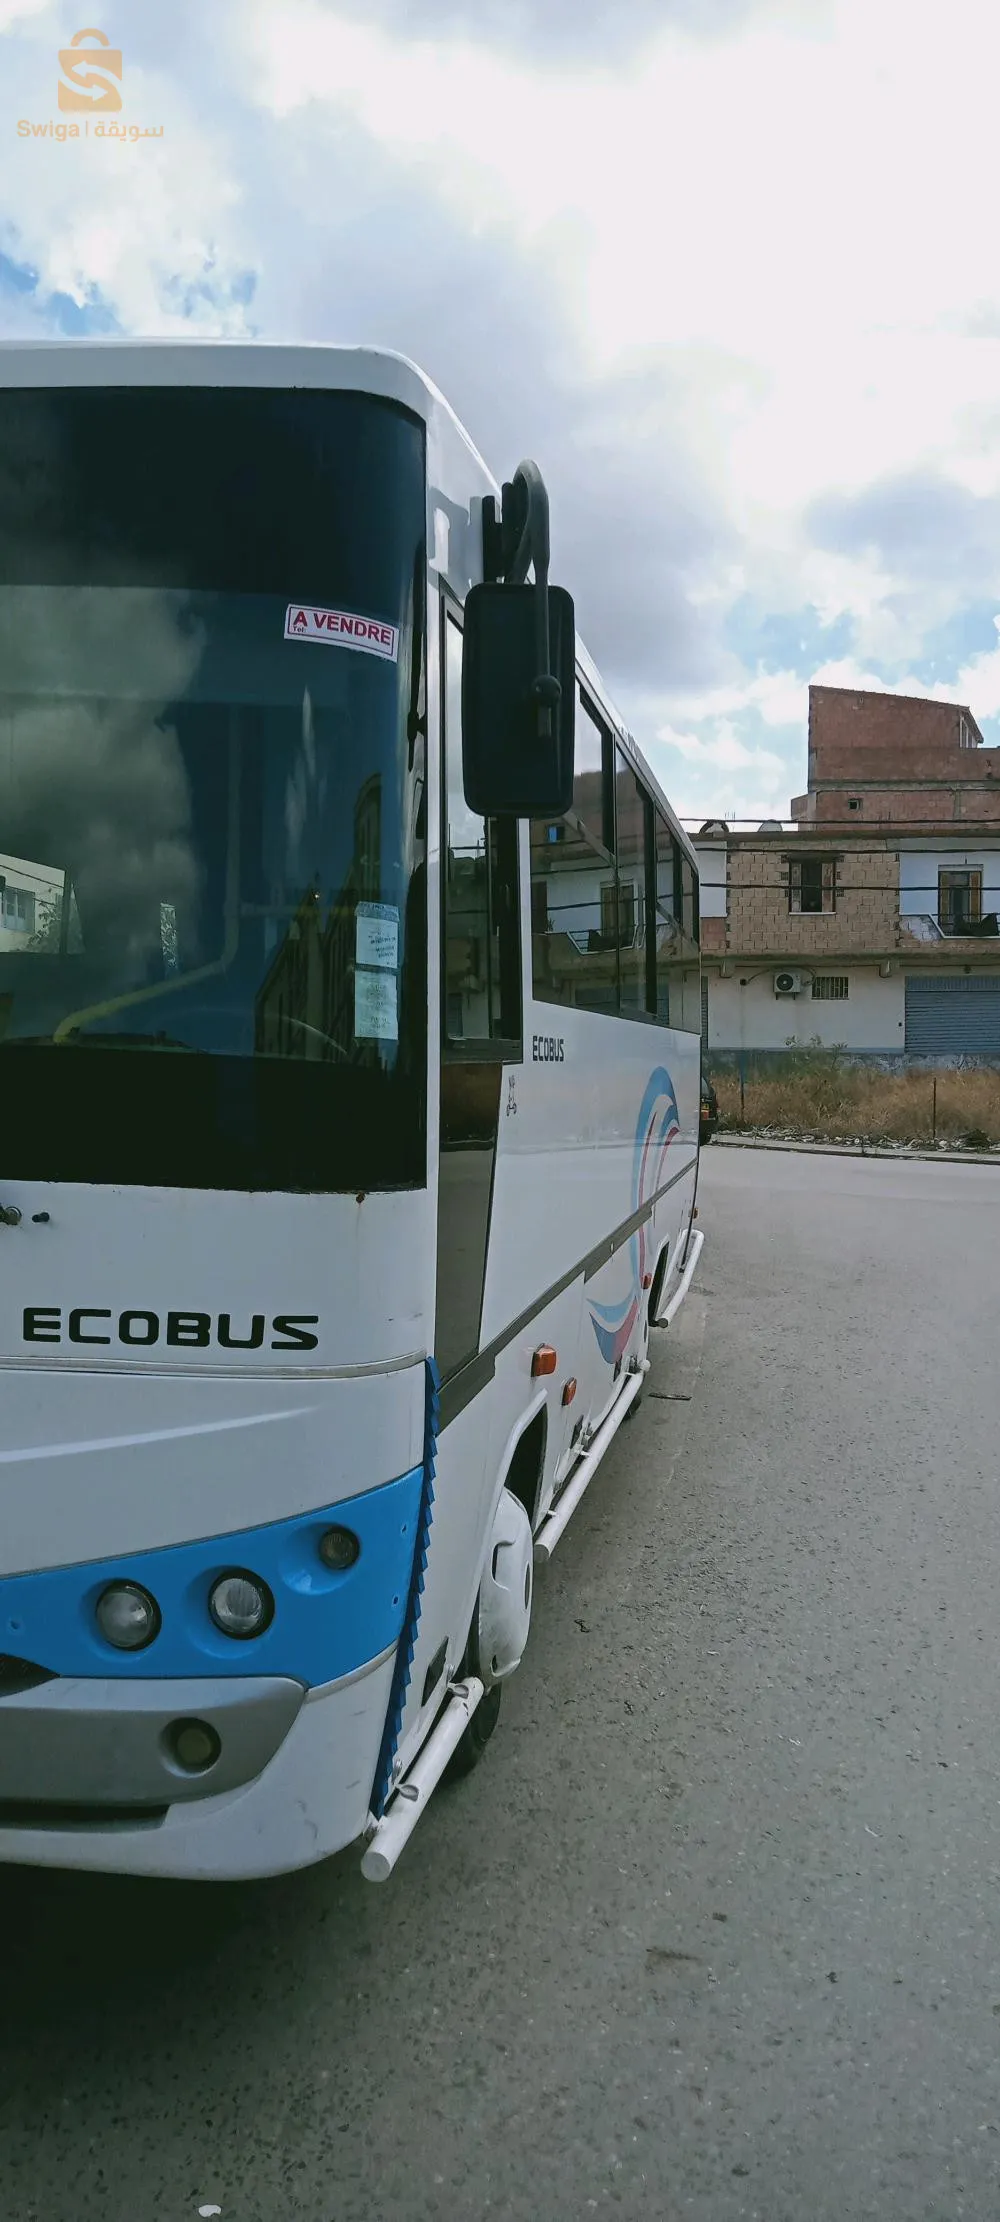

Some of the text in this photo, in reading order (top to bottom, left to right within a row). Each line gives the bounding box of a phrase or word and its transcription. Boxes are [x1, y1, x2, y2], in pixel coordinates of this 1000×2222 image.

[293, 611, 391, 645] A VENDRE
[532, 1036, 565, 1061] ECOBUS
[22, 1307, 319, 1351] ECOBUS
